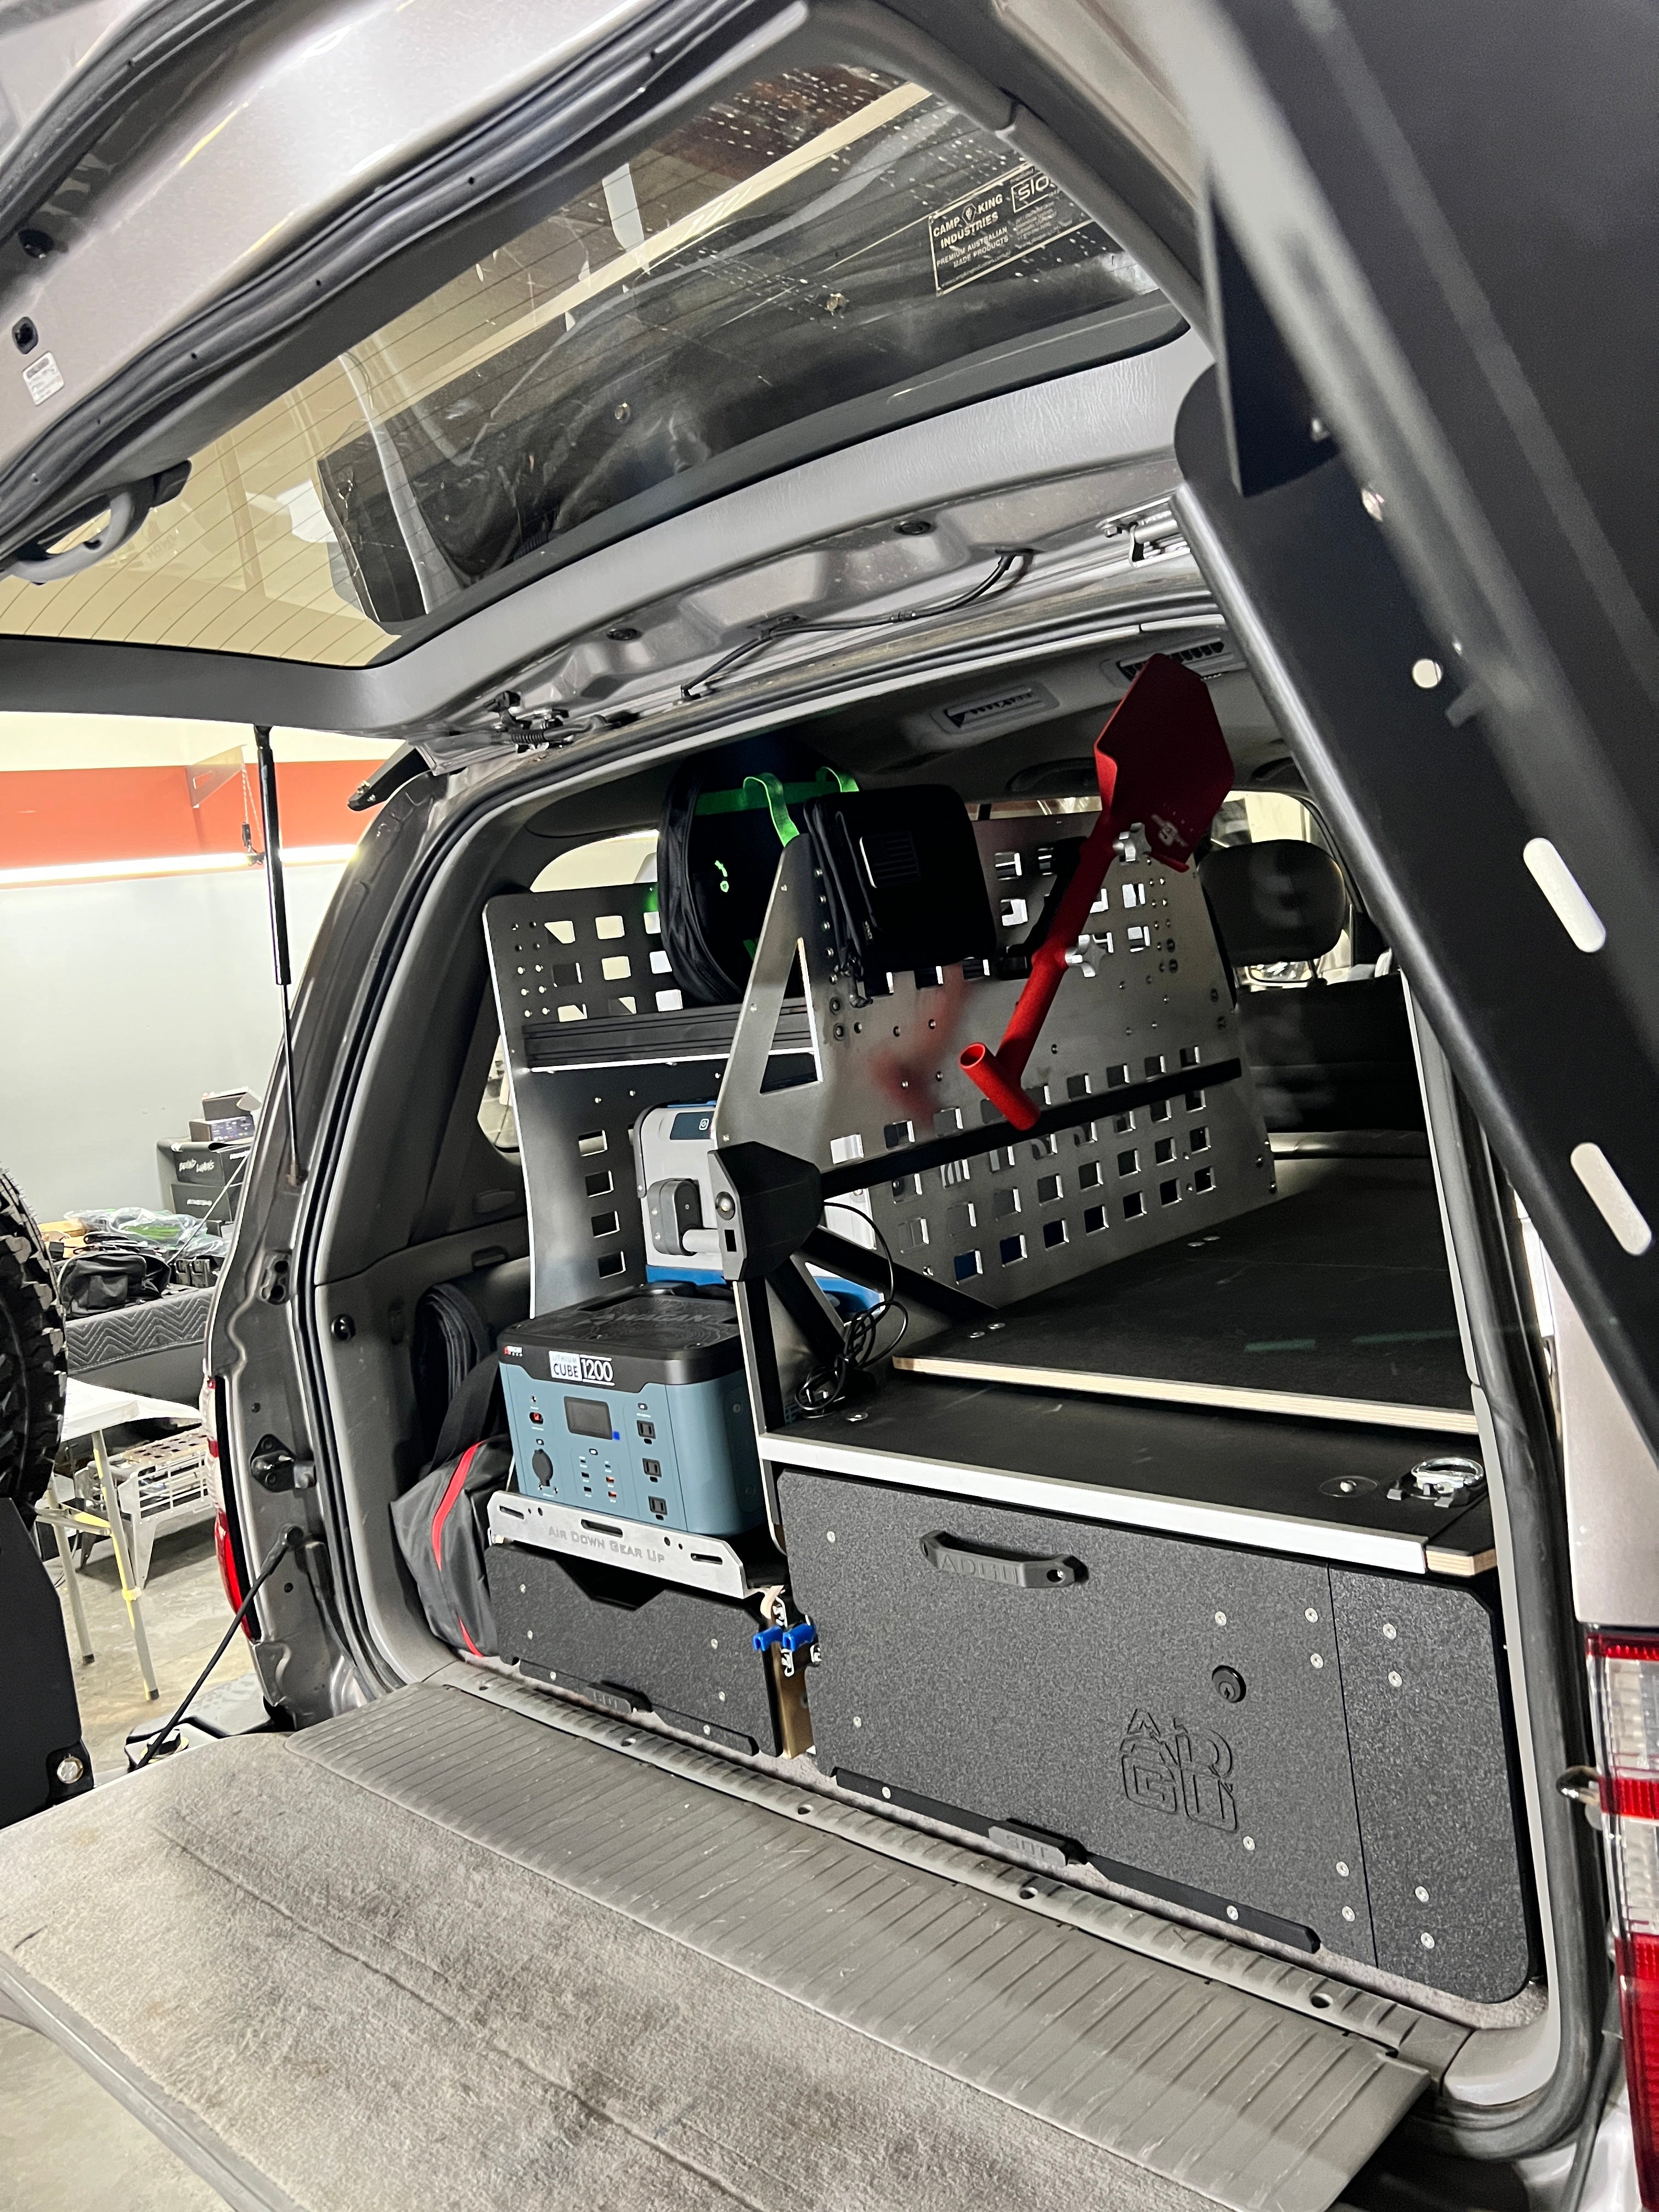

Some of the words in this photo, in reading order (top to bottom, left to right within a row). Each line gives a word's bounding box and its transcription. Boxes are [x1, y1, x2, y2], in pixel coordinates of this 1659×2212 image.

[933, 216, 960, 237] CAMP
[978, 194, 1003, 215] KING
[940, 211, 998, 249] INDUSTRIES
[936, 247, 966, 267] PREMIUM
[967, 226, 1008, 252] AUSTRALIAN
[953, 254, 971, 268] MADE
[973, 235, 1009, 257] PRODUCTS
[553, 1363, 579, 1378] CUBE
[580, 1358, 613, 1382] 1200
[549, 1525, 567, 1539] AIR
[571, 1531, 606, 1549] DOWN
[610, 1540, 643, 1559] GEAR
[647, 1548, 665, 1564] UP
